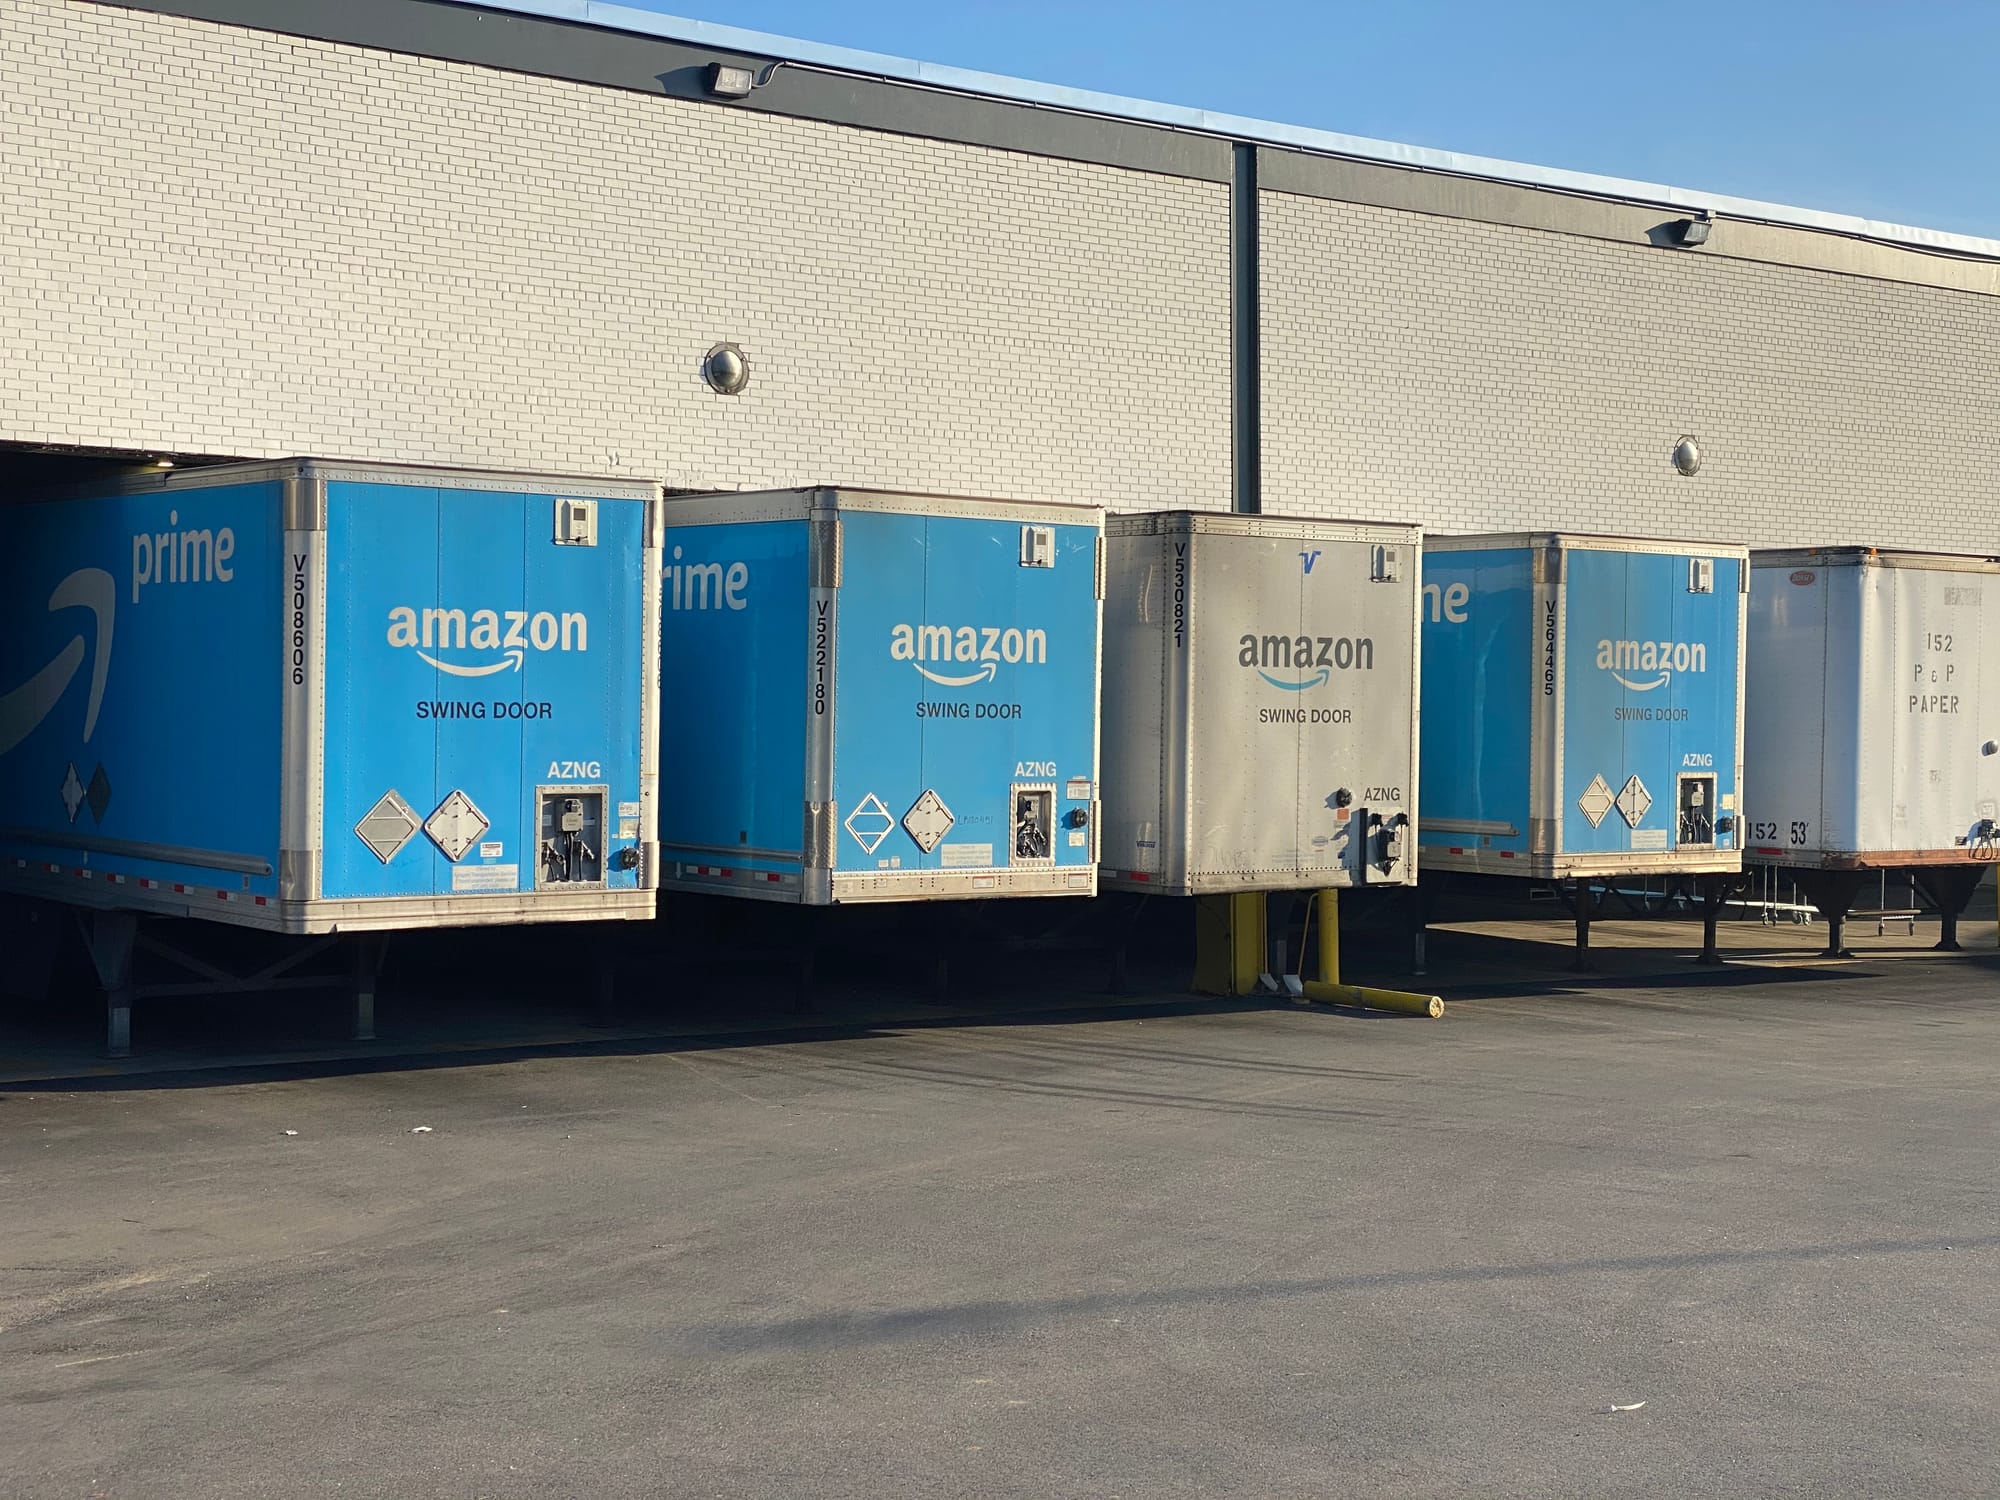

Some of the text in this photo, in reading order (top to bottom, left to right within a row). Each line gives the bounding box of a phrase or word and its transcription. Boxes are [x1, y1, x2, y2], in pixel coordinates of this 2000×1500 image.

[133, 510, 235, 604] prime
[1174, 542, 1186, 648] V530821
[293, 554, 308, 685] V508606
[387, 606, 588, 652] amazon
[891, 623, 1047, 665] amazon
[1545, 600, 1556, 695] V564465
[1927, 632, 1953, 652] 152
[815, 601, 829, 715] V522180
[1238, 634, 1374, 670] amazon
[1597, 639, 1706, 673] amazon
[1914, 663, 1923, 682] P
[1946, 664, 1954, 682] P
[416, 701, 553, 719] SWING DOOR
[916, 702, 1022, 719] SWING DOOR
[1909, 695, 1959, 714] PAPER
[1259, 708, 1352, 724] SWING DOOR
[1614, 708, 1690, 721] SWING DOOR
[1014, 761, 1057, 777] AZNG
[1682, 753, 1713, 767] AZNG
[547, 761, 601, 779] AZNG
[1363, 787, 1400, 802] AZNG
[1748, 822, 1777, 840] 152
